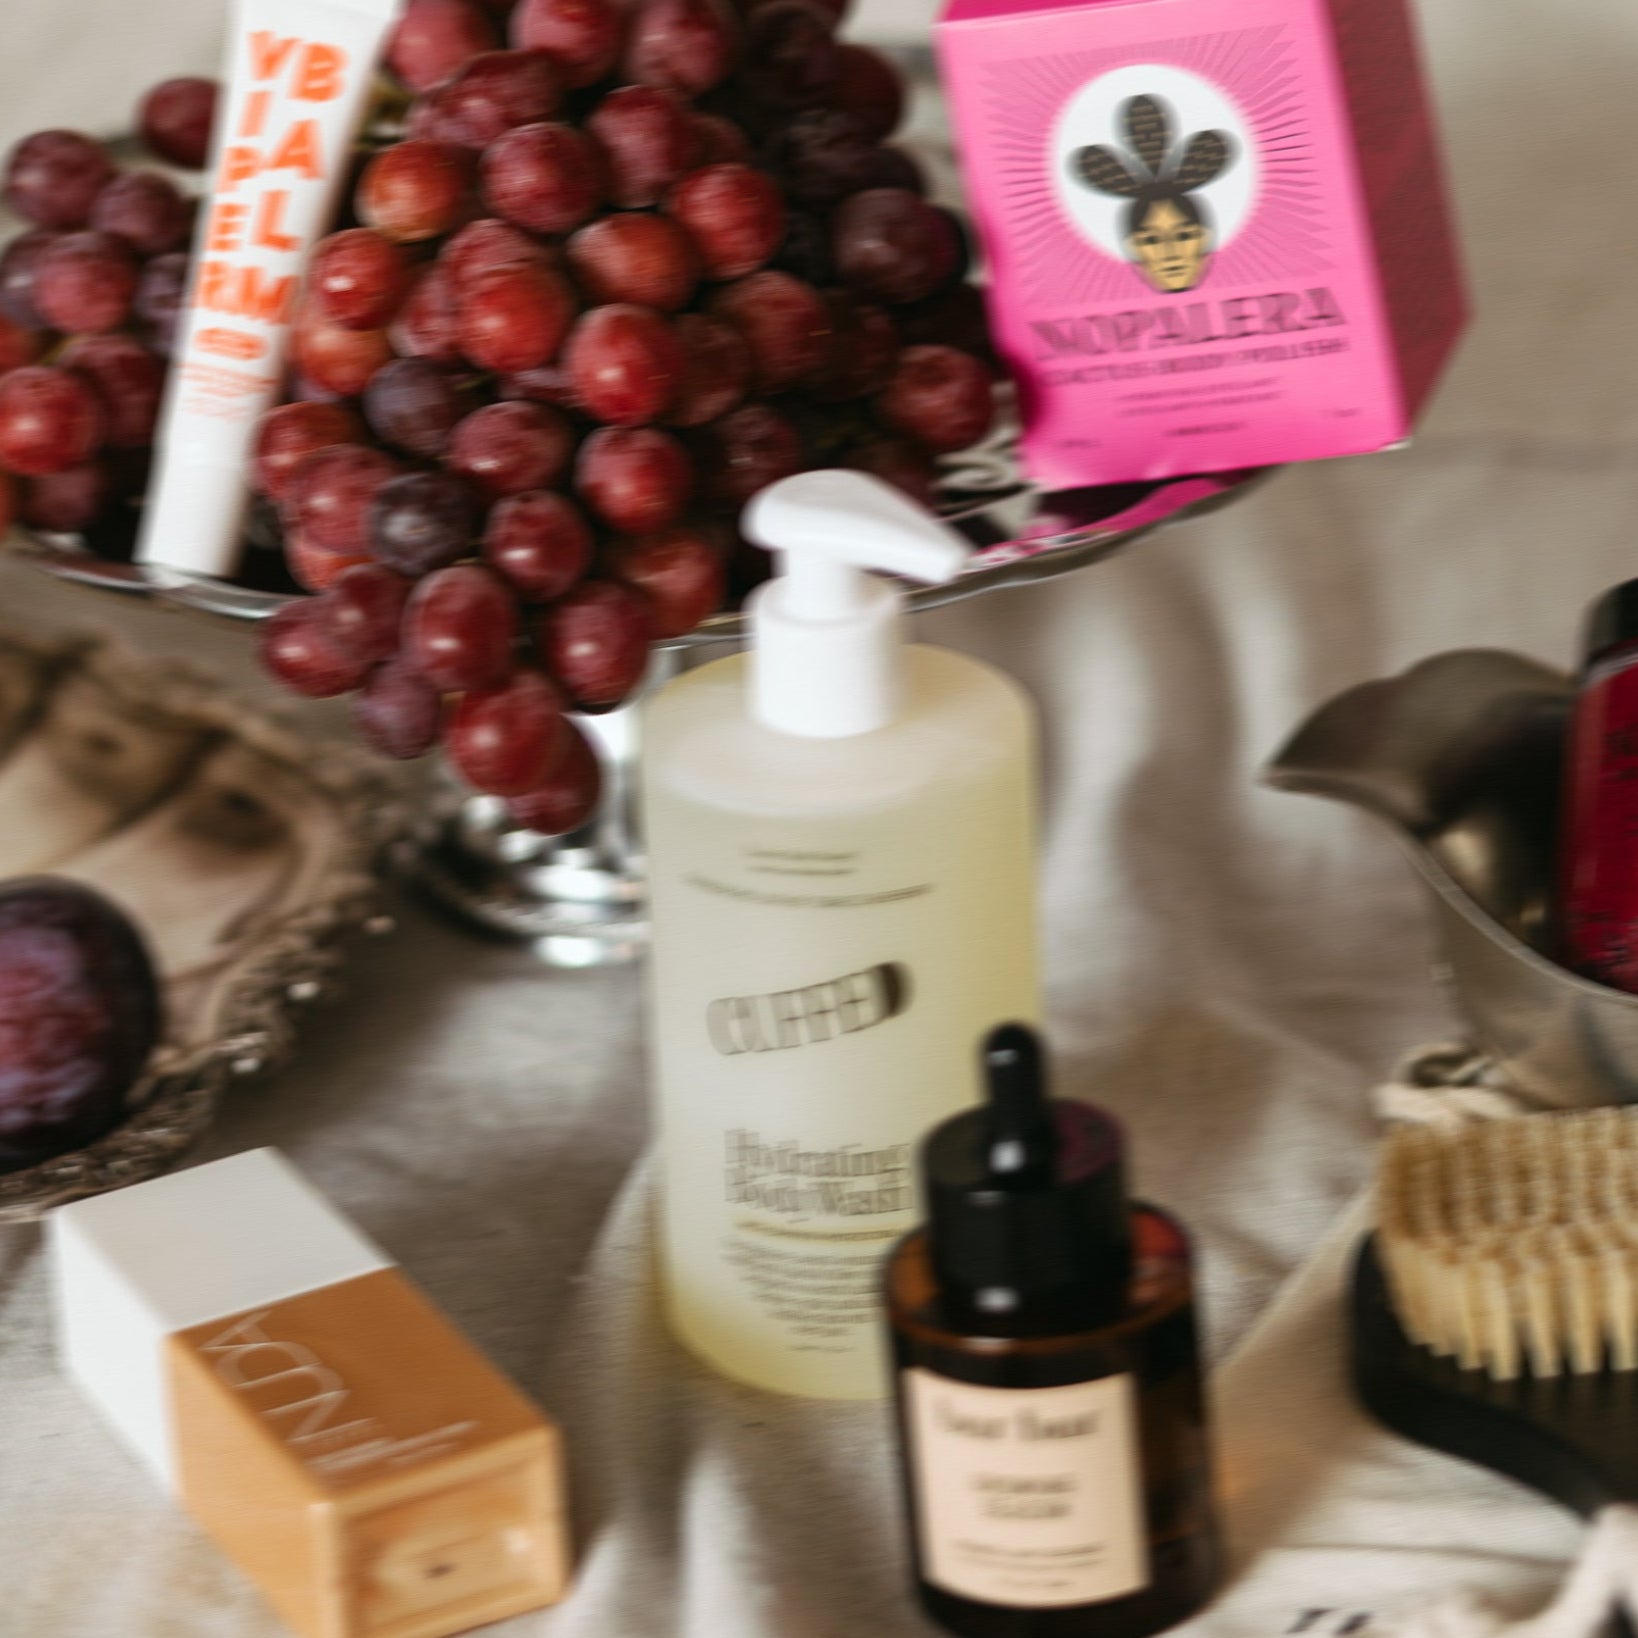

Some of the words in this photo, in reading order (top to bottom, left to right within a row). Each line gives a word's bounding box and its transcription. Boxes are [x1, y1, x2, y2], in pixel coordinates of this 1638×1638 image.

[231, 41, 347, 327] BALM
[1033, 286, 1342, 360] NOPALERA
[1043, 359, 1150, 388] CACTUS
[1159, 350, 1233, 376] BODY
[1242, 337, 1346, 365] POLISH
[730, 1130, 906, 1180] Hydrating
[730, 1165, 816, 1223] Body
[812, 1172, 909, 1217] Wash
